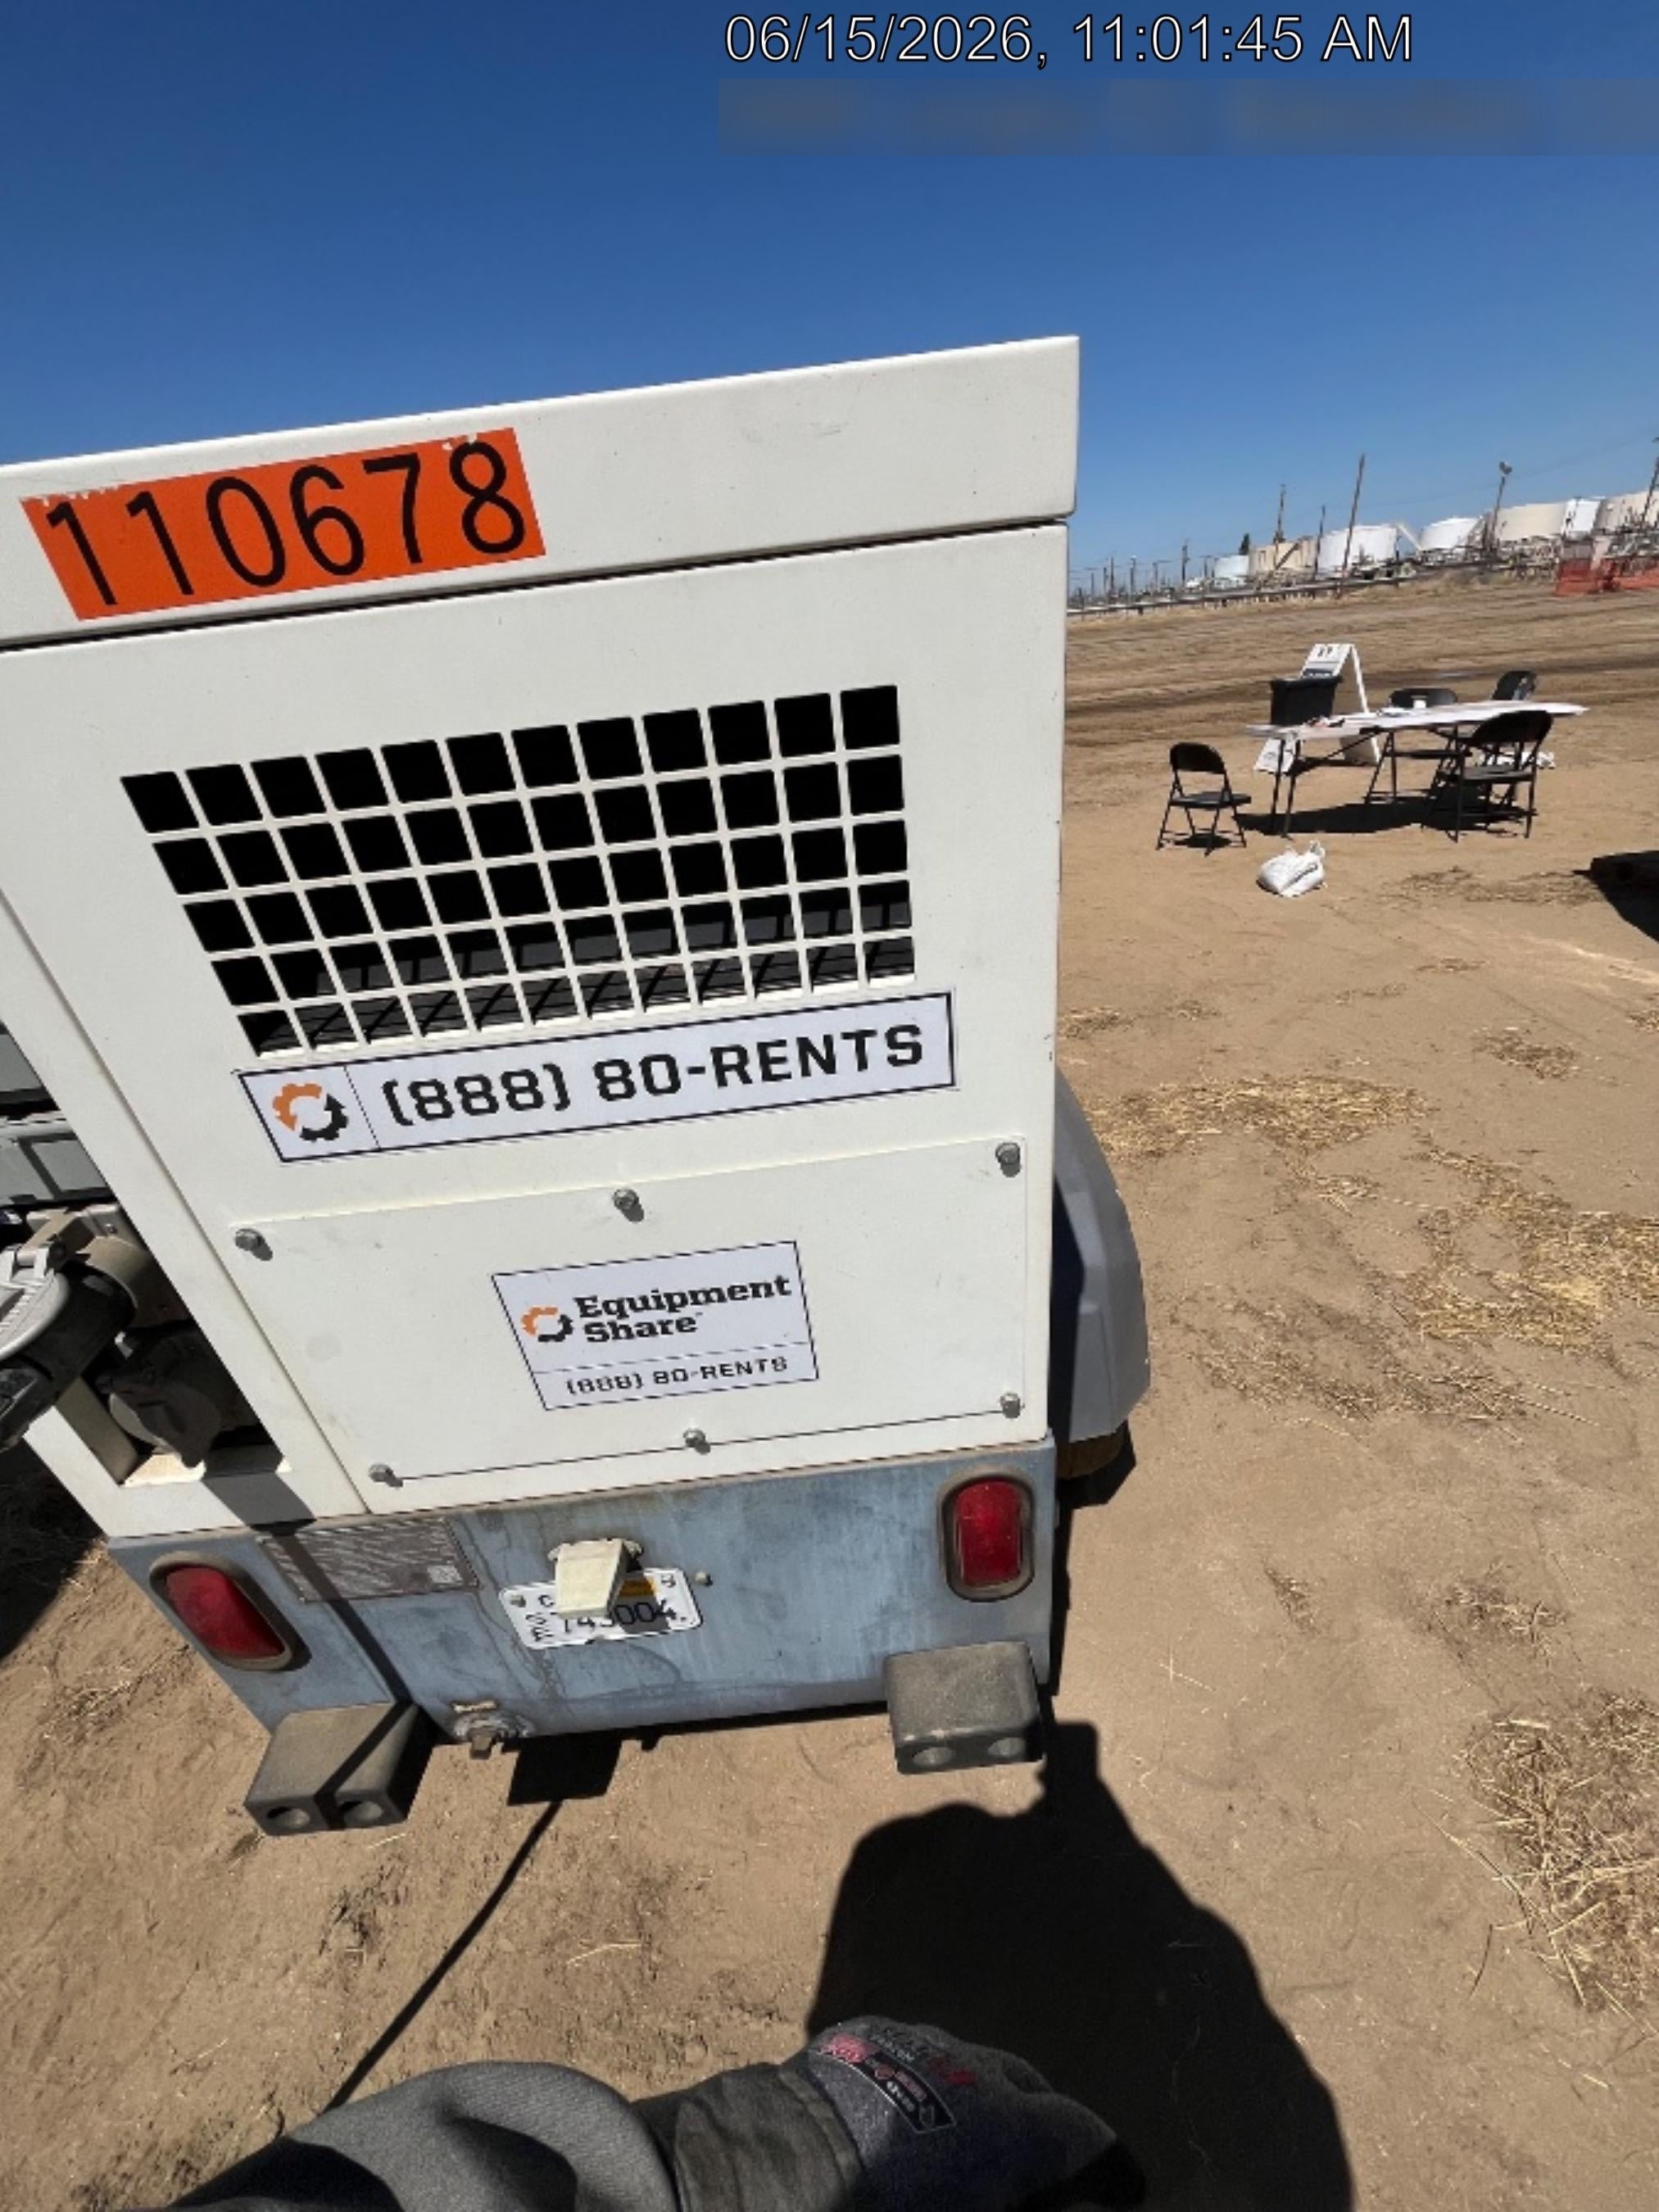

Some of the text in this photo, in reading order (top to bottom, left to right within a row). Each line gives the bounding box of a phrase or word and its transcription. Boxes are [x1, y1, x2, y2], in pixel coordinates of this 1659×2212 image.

[46, 441, 526, 606] 110678
[381, 1024, 922, 1126] (888) 80-RENTS
[573, 1275, 792, 1321] Equipment
[565, 1356, 788, 1395] (888) 80-RENTS
